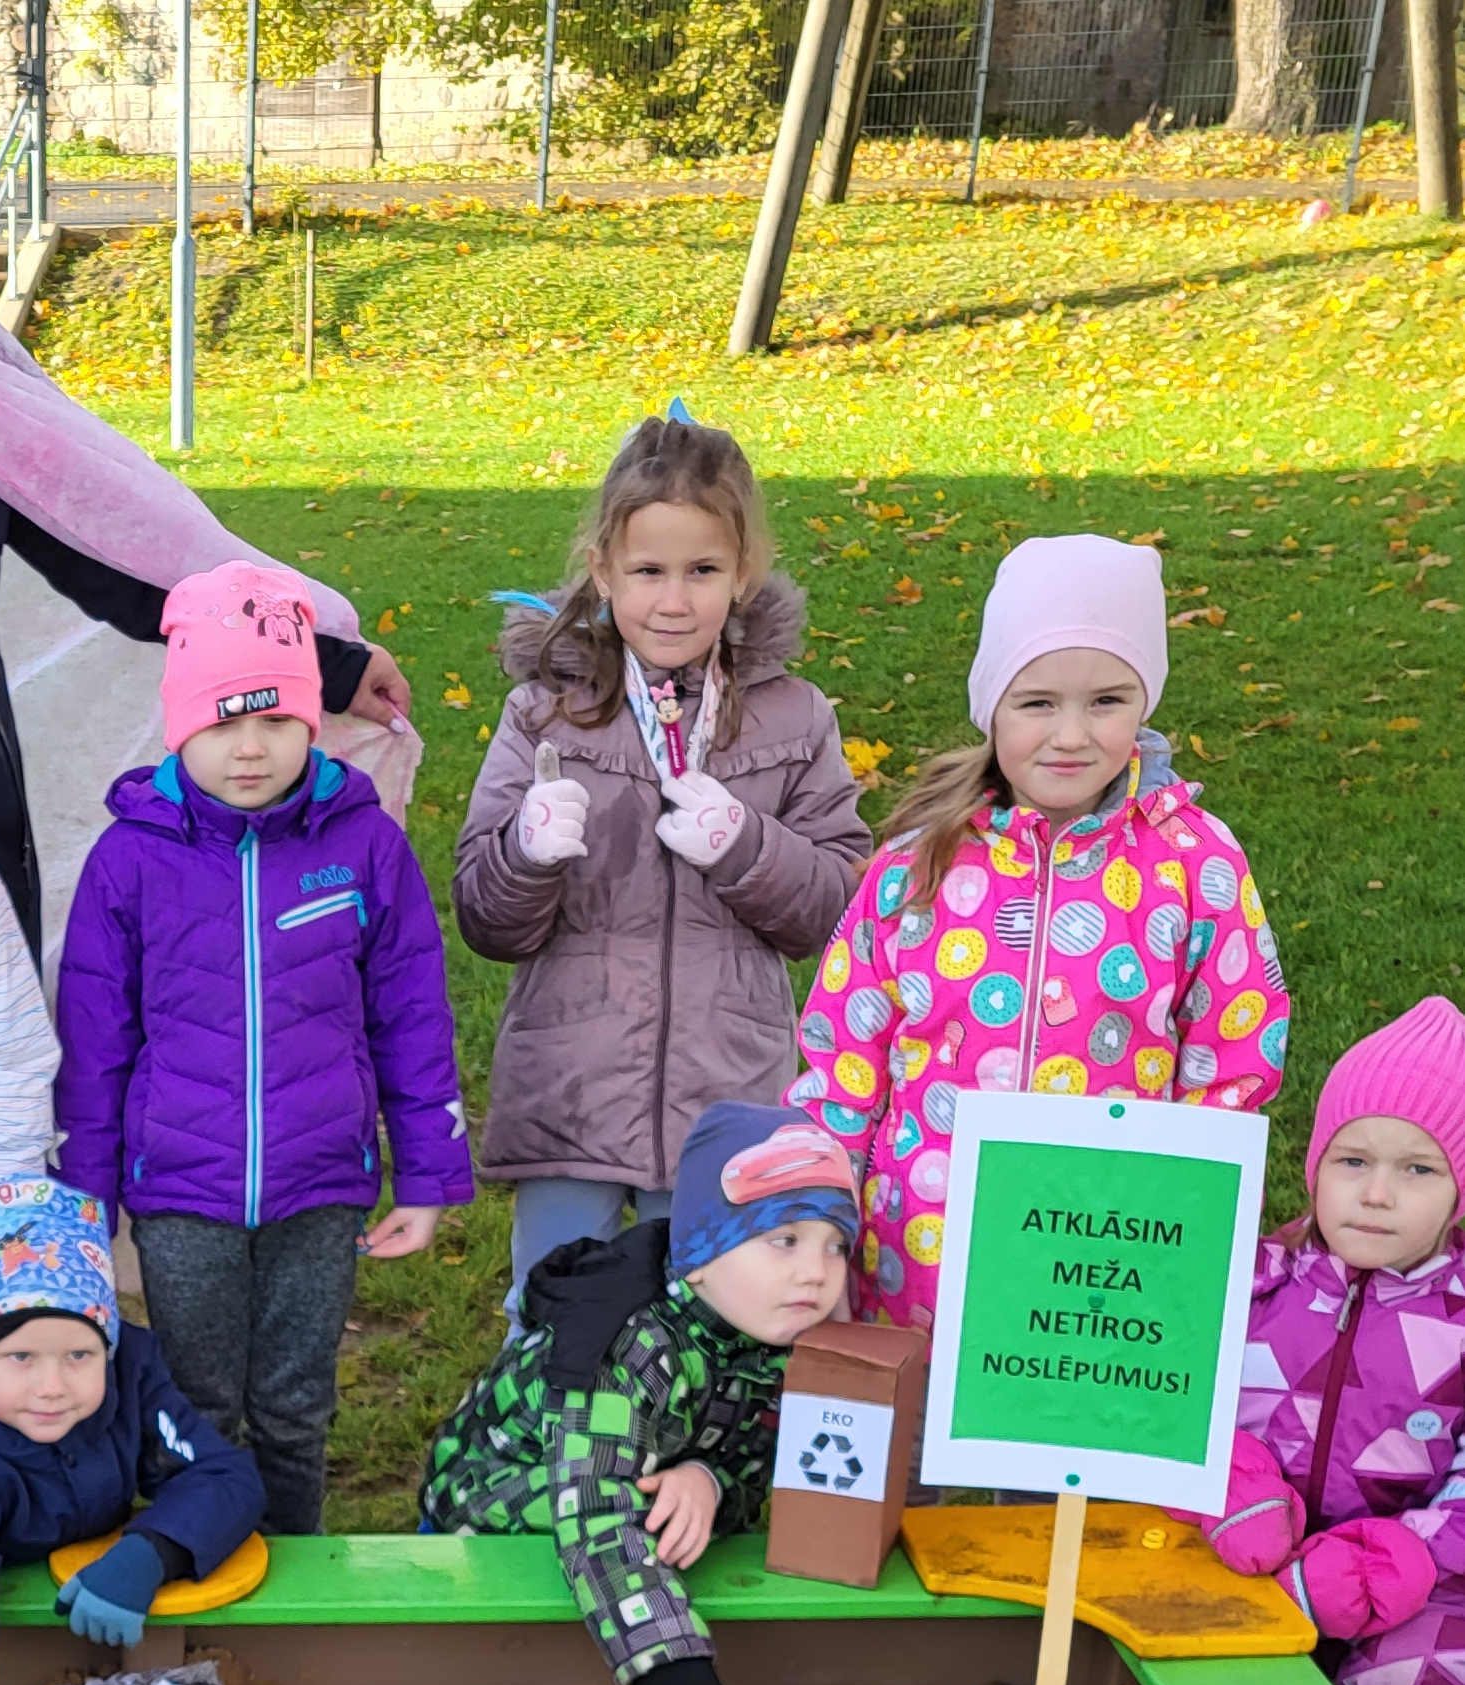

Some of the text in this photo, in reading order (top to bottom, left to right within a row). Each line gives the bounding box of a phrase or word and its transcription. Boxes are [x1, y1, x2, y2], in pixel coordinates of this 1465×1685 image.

[246, 689, 277, 711] MM
[1021, 1208, 1184, 1248] ATKLĀSIM
[1052, 1259, 1144, 1294] MEŽA
[1029, 1308, 1164, 1346] NETĪROS
[982, 1353, 1191, 1396] NOSLĒPUMUS!
[821, 1410, 854, 1428] EKO
